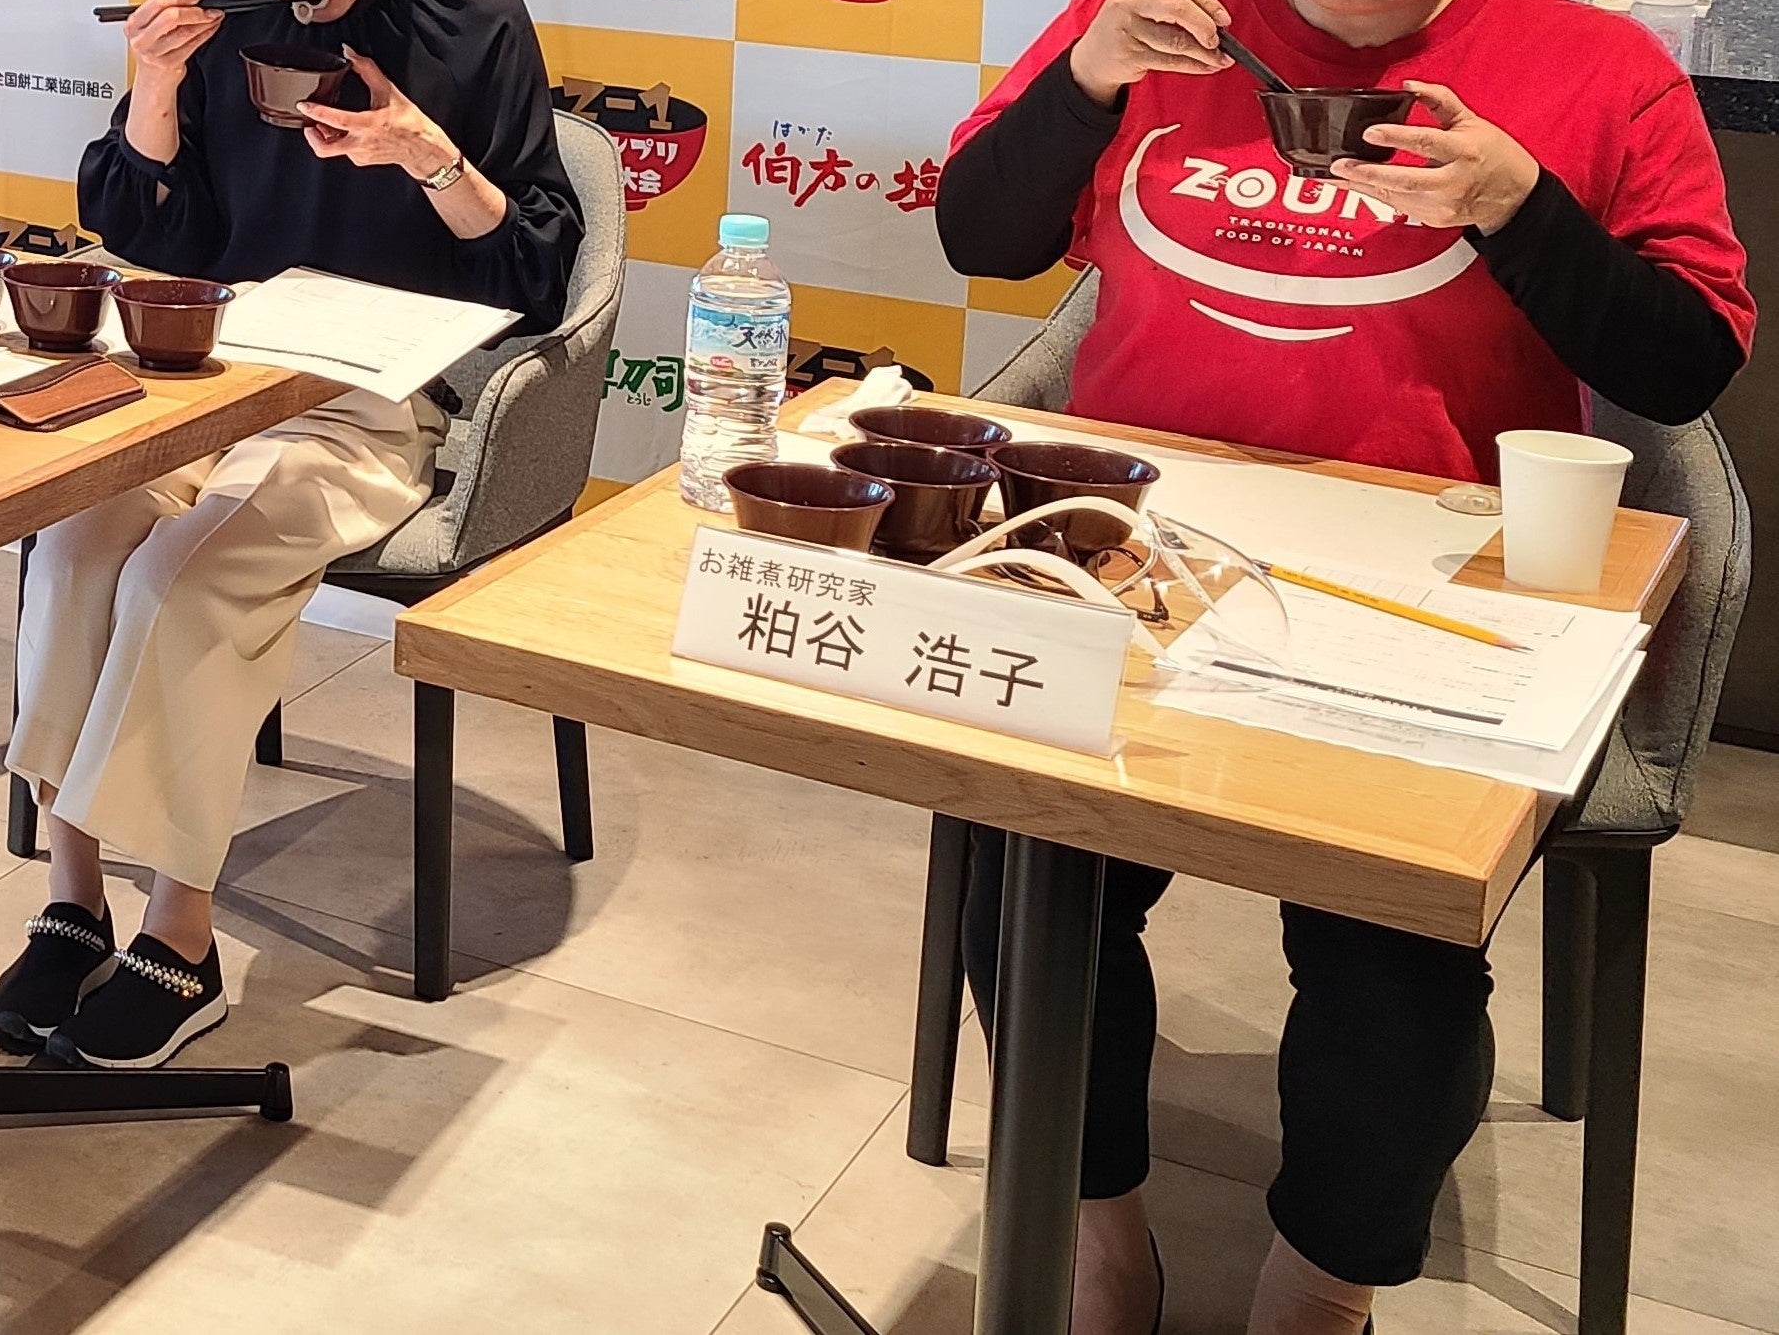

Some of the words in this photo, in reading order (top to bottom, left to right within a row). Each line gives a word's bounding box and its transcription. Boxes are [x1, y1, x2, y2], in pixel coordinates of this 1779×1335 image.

[742, 141, 943, 212] 伯方の塩
[1170, 156, 1423, 227] ZOUN
[1214, 228, 1262, 246] FOOD
[1271, 235, 1294, 247] OF
[1303, 241, 1364, 258] JAPAN
[1228, 216, 1354, 240] TRADITIONAL
[732, 324, 787, 349] 天然水
[601, 349, 685, 412] 刀司
[698, 546, 877, 607] お雑煮研究家
[737, 593, 865, 672] 粕谷
[904, 632, 1044, 707] 浩子
